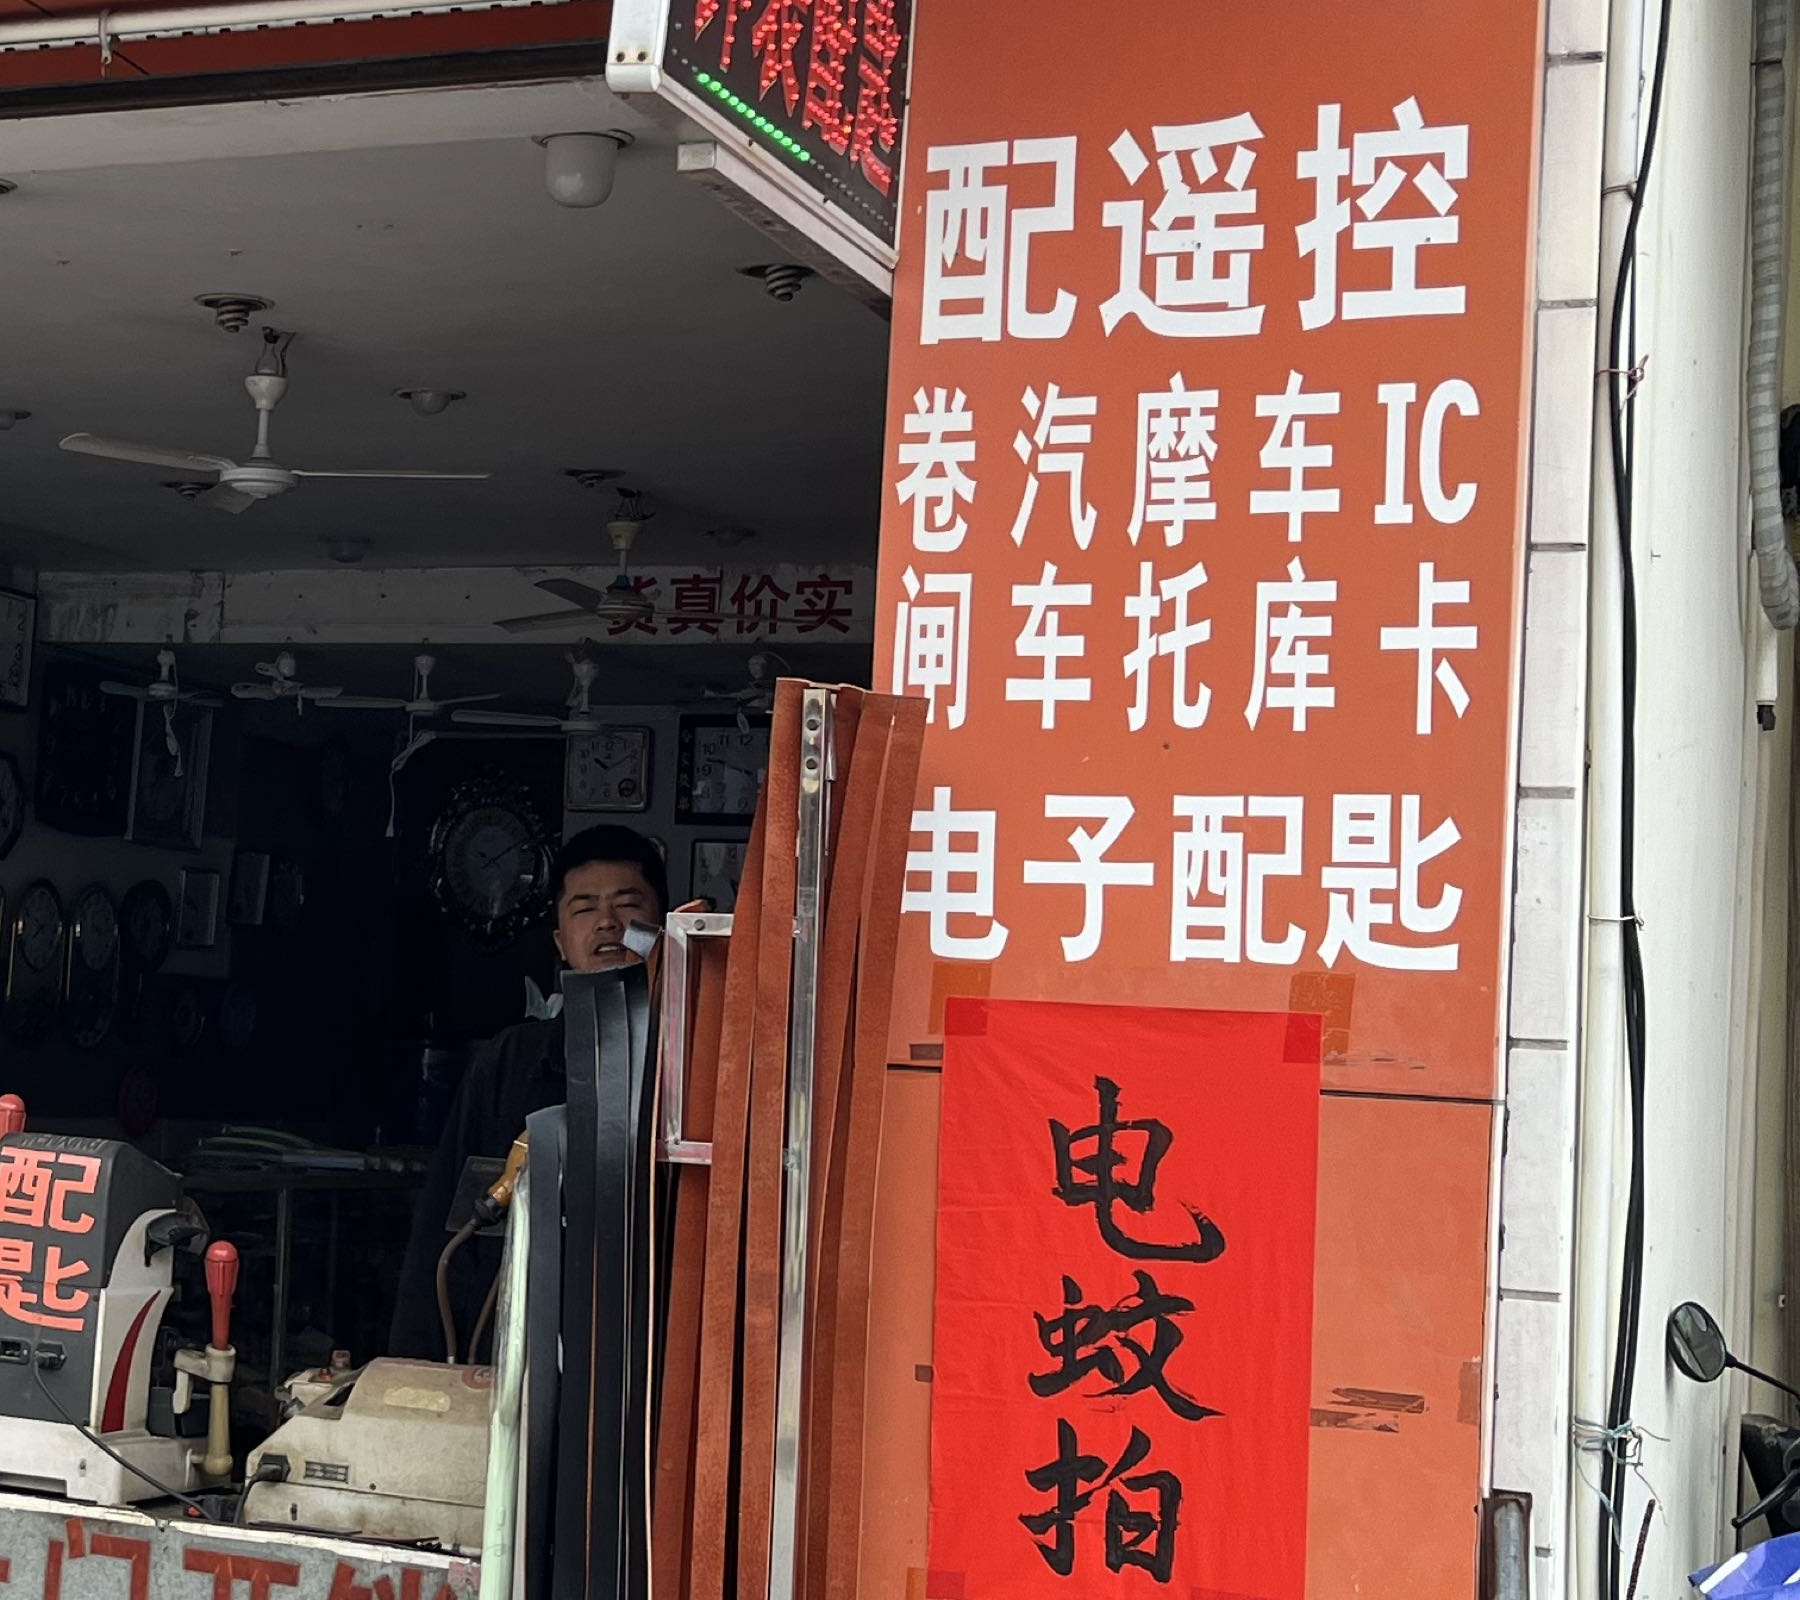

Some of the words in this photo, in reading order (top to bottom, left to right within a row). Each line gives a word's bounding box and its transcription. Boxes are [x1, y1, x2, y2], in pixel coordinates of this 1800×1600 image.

[920, 96, 1469, 345] 配遥控
[903, 787, 1464, 971] 电子配匙
[1018, 1076, 1227, 1583] 电蚊拍
